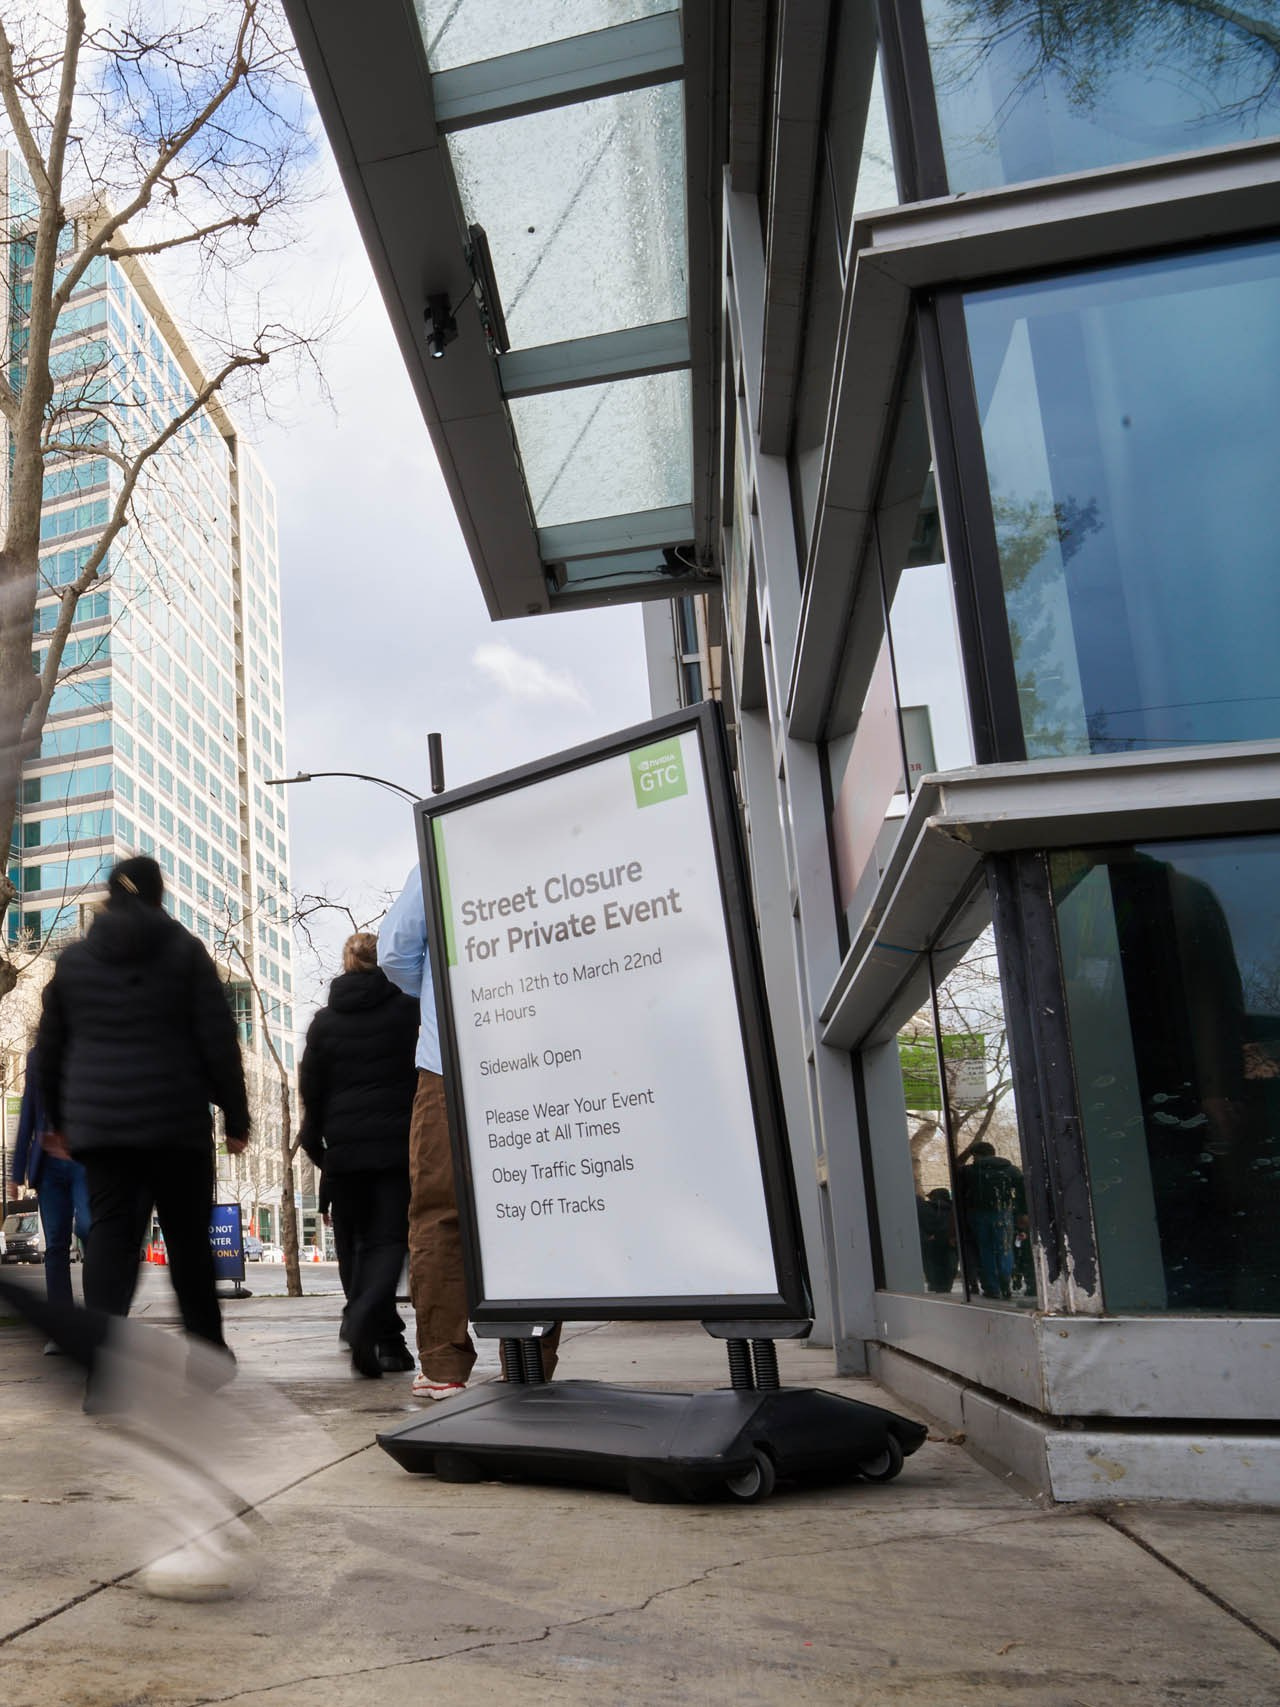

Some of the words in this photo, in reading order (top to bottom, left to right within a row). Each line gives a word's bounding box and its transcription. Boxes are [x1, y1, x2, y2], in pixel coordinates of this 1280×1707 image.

[640, 764, 680, 792] GTC
[461, 885, 538, 926] Street
[544, 860, 643, 904] Closure
[464, 935, 500, 962] for
[508, 914, 596, 954] Private
[604, 887, 682, 930] Event
[471, 980, 514, 1003] March
[519, 974, 550, 995] 12th
[553, 970, 568, 986] to
[572, 959, 620, 983] March
[624, 948, 663, 971] 22nd
[474, 1012, 492, 1027] 24
[495, 1003, 537, 1024] Hours
[479, 1053, 540, 1076] Sidewalk
[543, 1048, 582, 1069] Open
[486, 1107, 530, 1125] Please
[533, 1103, 570, 1120] Wear
[574, 1097, 607, 1114] Your
[612, 1088, 655, 1109] Event
[488, 1130, 532, 1149] Badge
[535, 1128, 551, 1144] at
[554, 1124, 572, 1141] All
[575, 1120, 620, 1139] Times
[492, 1167, 527, 1184] Obey
[531, 1162, 576, 1180] Traffic
[581, 1155, 634, 1178] Signals
[496, 1203, 526, 1221] Stay
[530, 1199, 554, 1217] Off
[557, 1196, 606, 1214] Tracks
[210, 1237, 232, 1246] NTER
[215, 1225, 232, 1233] NOT
